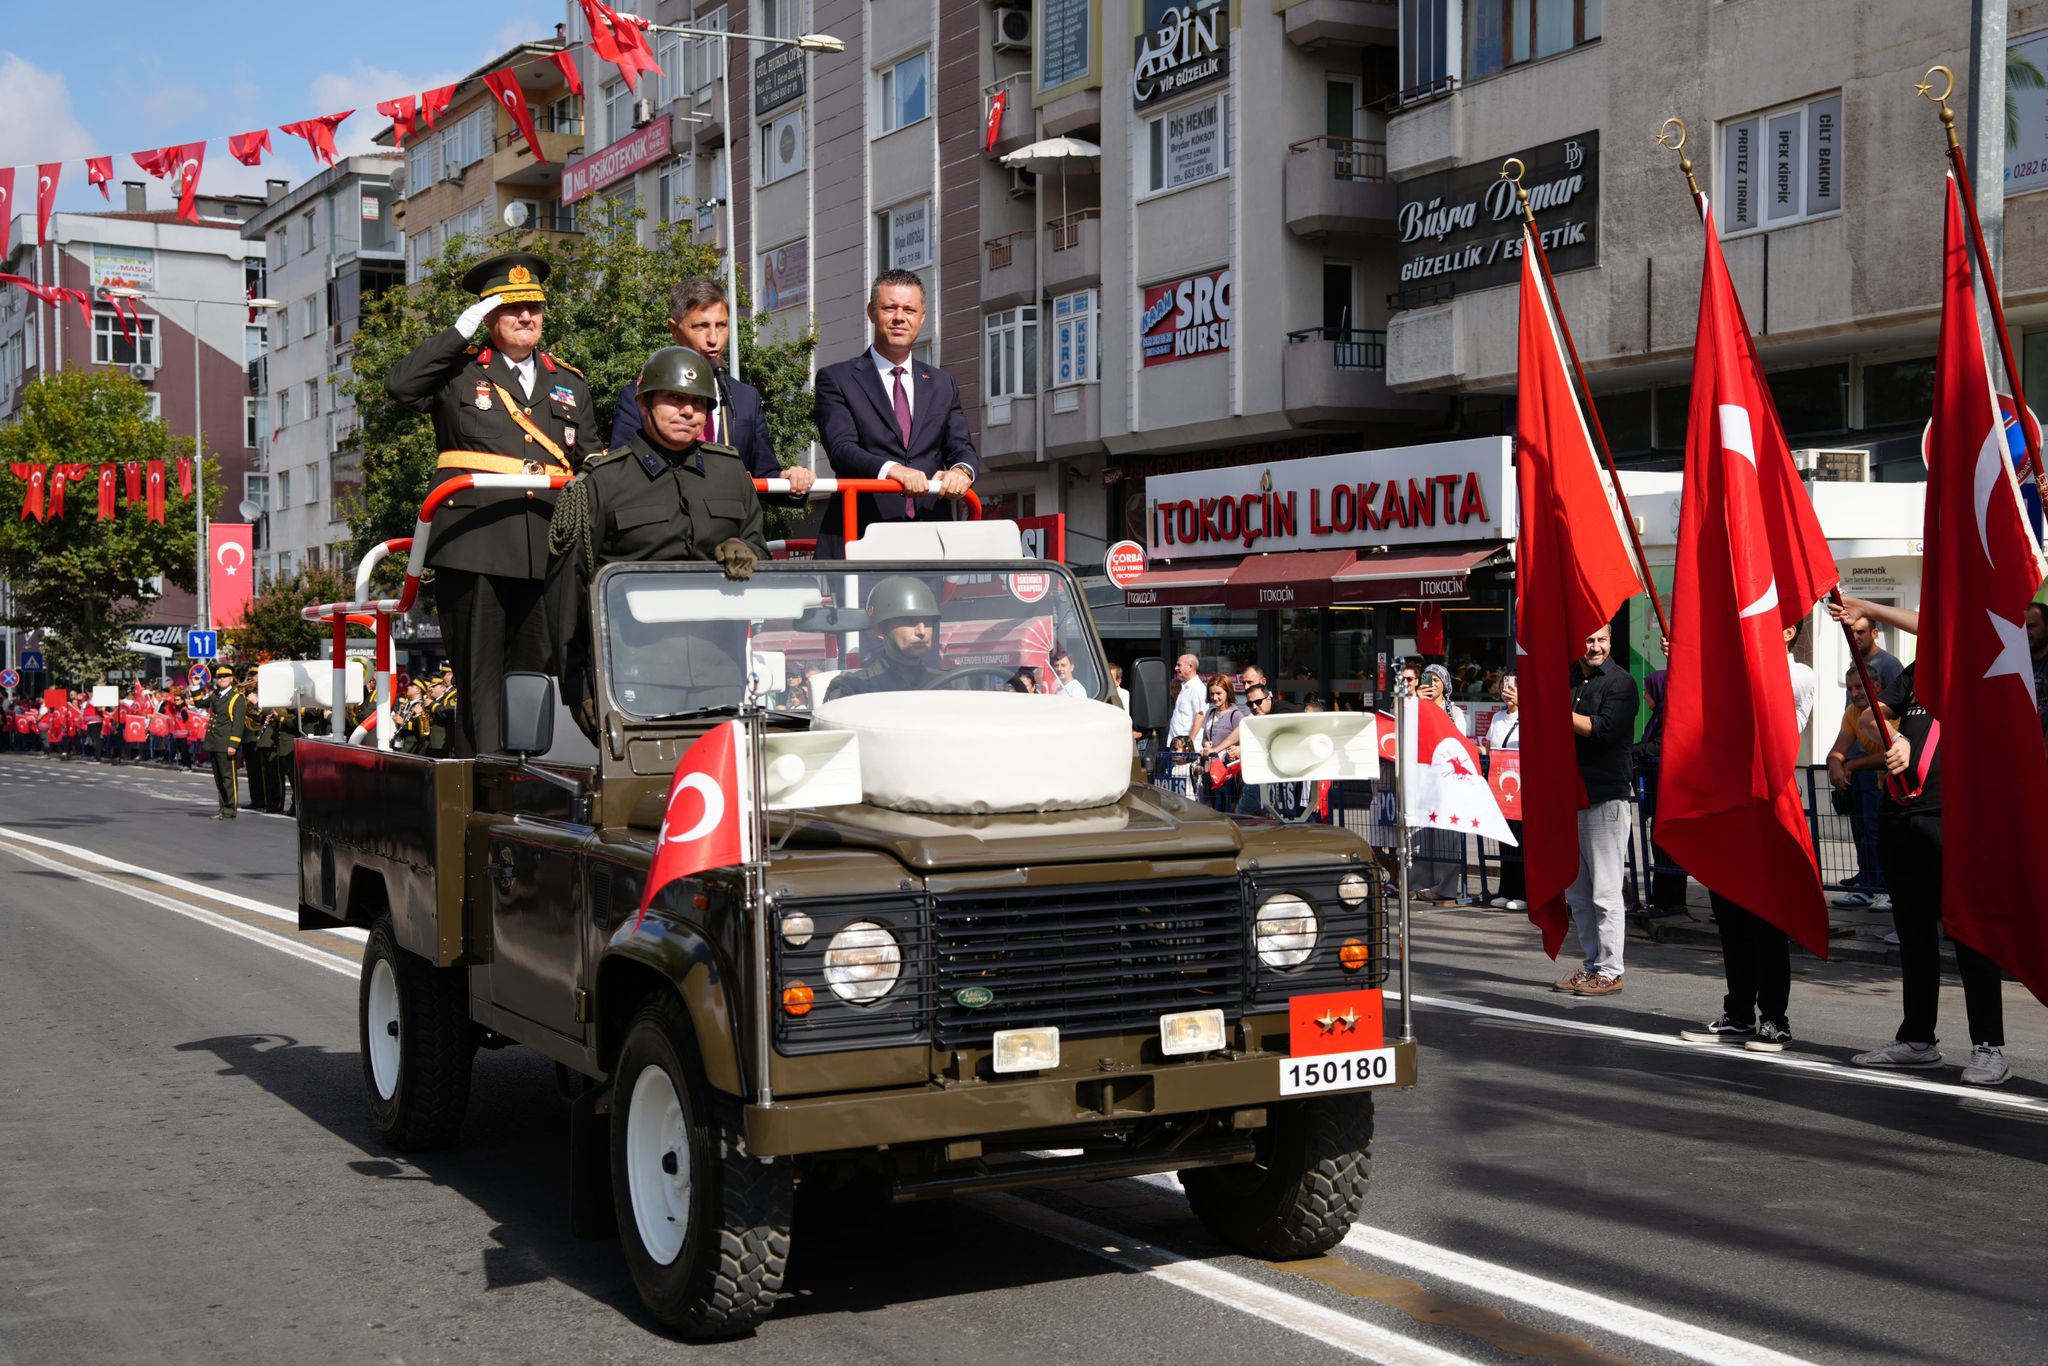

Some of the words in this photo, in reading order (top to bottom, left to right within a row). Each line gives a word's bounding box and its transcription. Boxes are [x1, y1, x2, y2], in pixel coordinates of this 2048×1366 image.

[1176, 58, 1218, 86] GÜZELLİK
[1170, 115, 1184, 140] DİŞ
[1186, 101, 1217, 133] HEKİMİ
[1818, 114, 1834, 143] CİLT
[1737, 128, 1749, 174] PROTEZ
[1778, 130, 1792, 158] İPEK
[1777, 162, 1791, 204] KİRPİK
[1818, 147, 1831, 197] BAKIMI
[2013, 160, 2038, 179] 0282
[1398, 196, 1477, 243] Büşra
[1736, 178, 1748, 223] TIRNAK
[1401, 244, 1481, 281] GÜZELLİK
[1503, 221, 1584, 259] ESETİK
[1176, 271, 1232, 330] SRC
[1061, 329, 1070, 379] SRC
[1077, 322, 1086, 377] KURSU
[1175, 320, 1230, 356] KURSU
[1158, 490, 1297, 549] TOKOÇİN
[1310, 472, 1490, 535] LOKANTA
[1112, 552, 1143, 566] ÇORBA
[1852, 565, 1887, 577] paramatik
[1263, 585, 1294, 603] TOKOÇİN
[1423, 576, 1463, 596] TOKOÇİN
[1289, 1056, 1388, 1088] 150180
